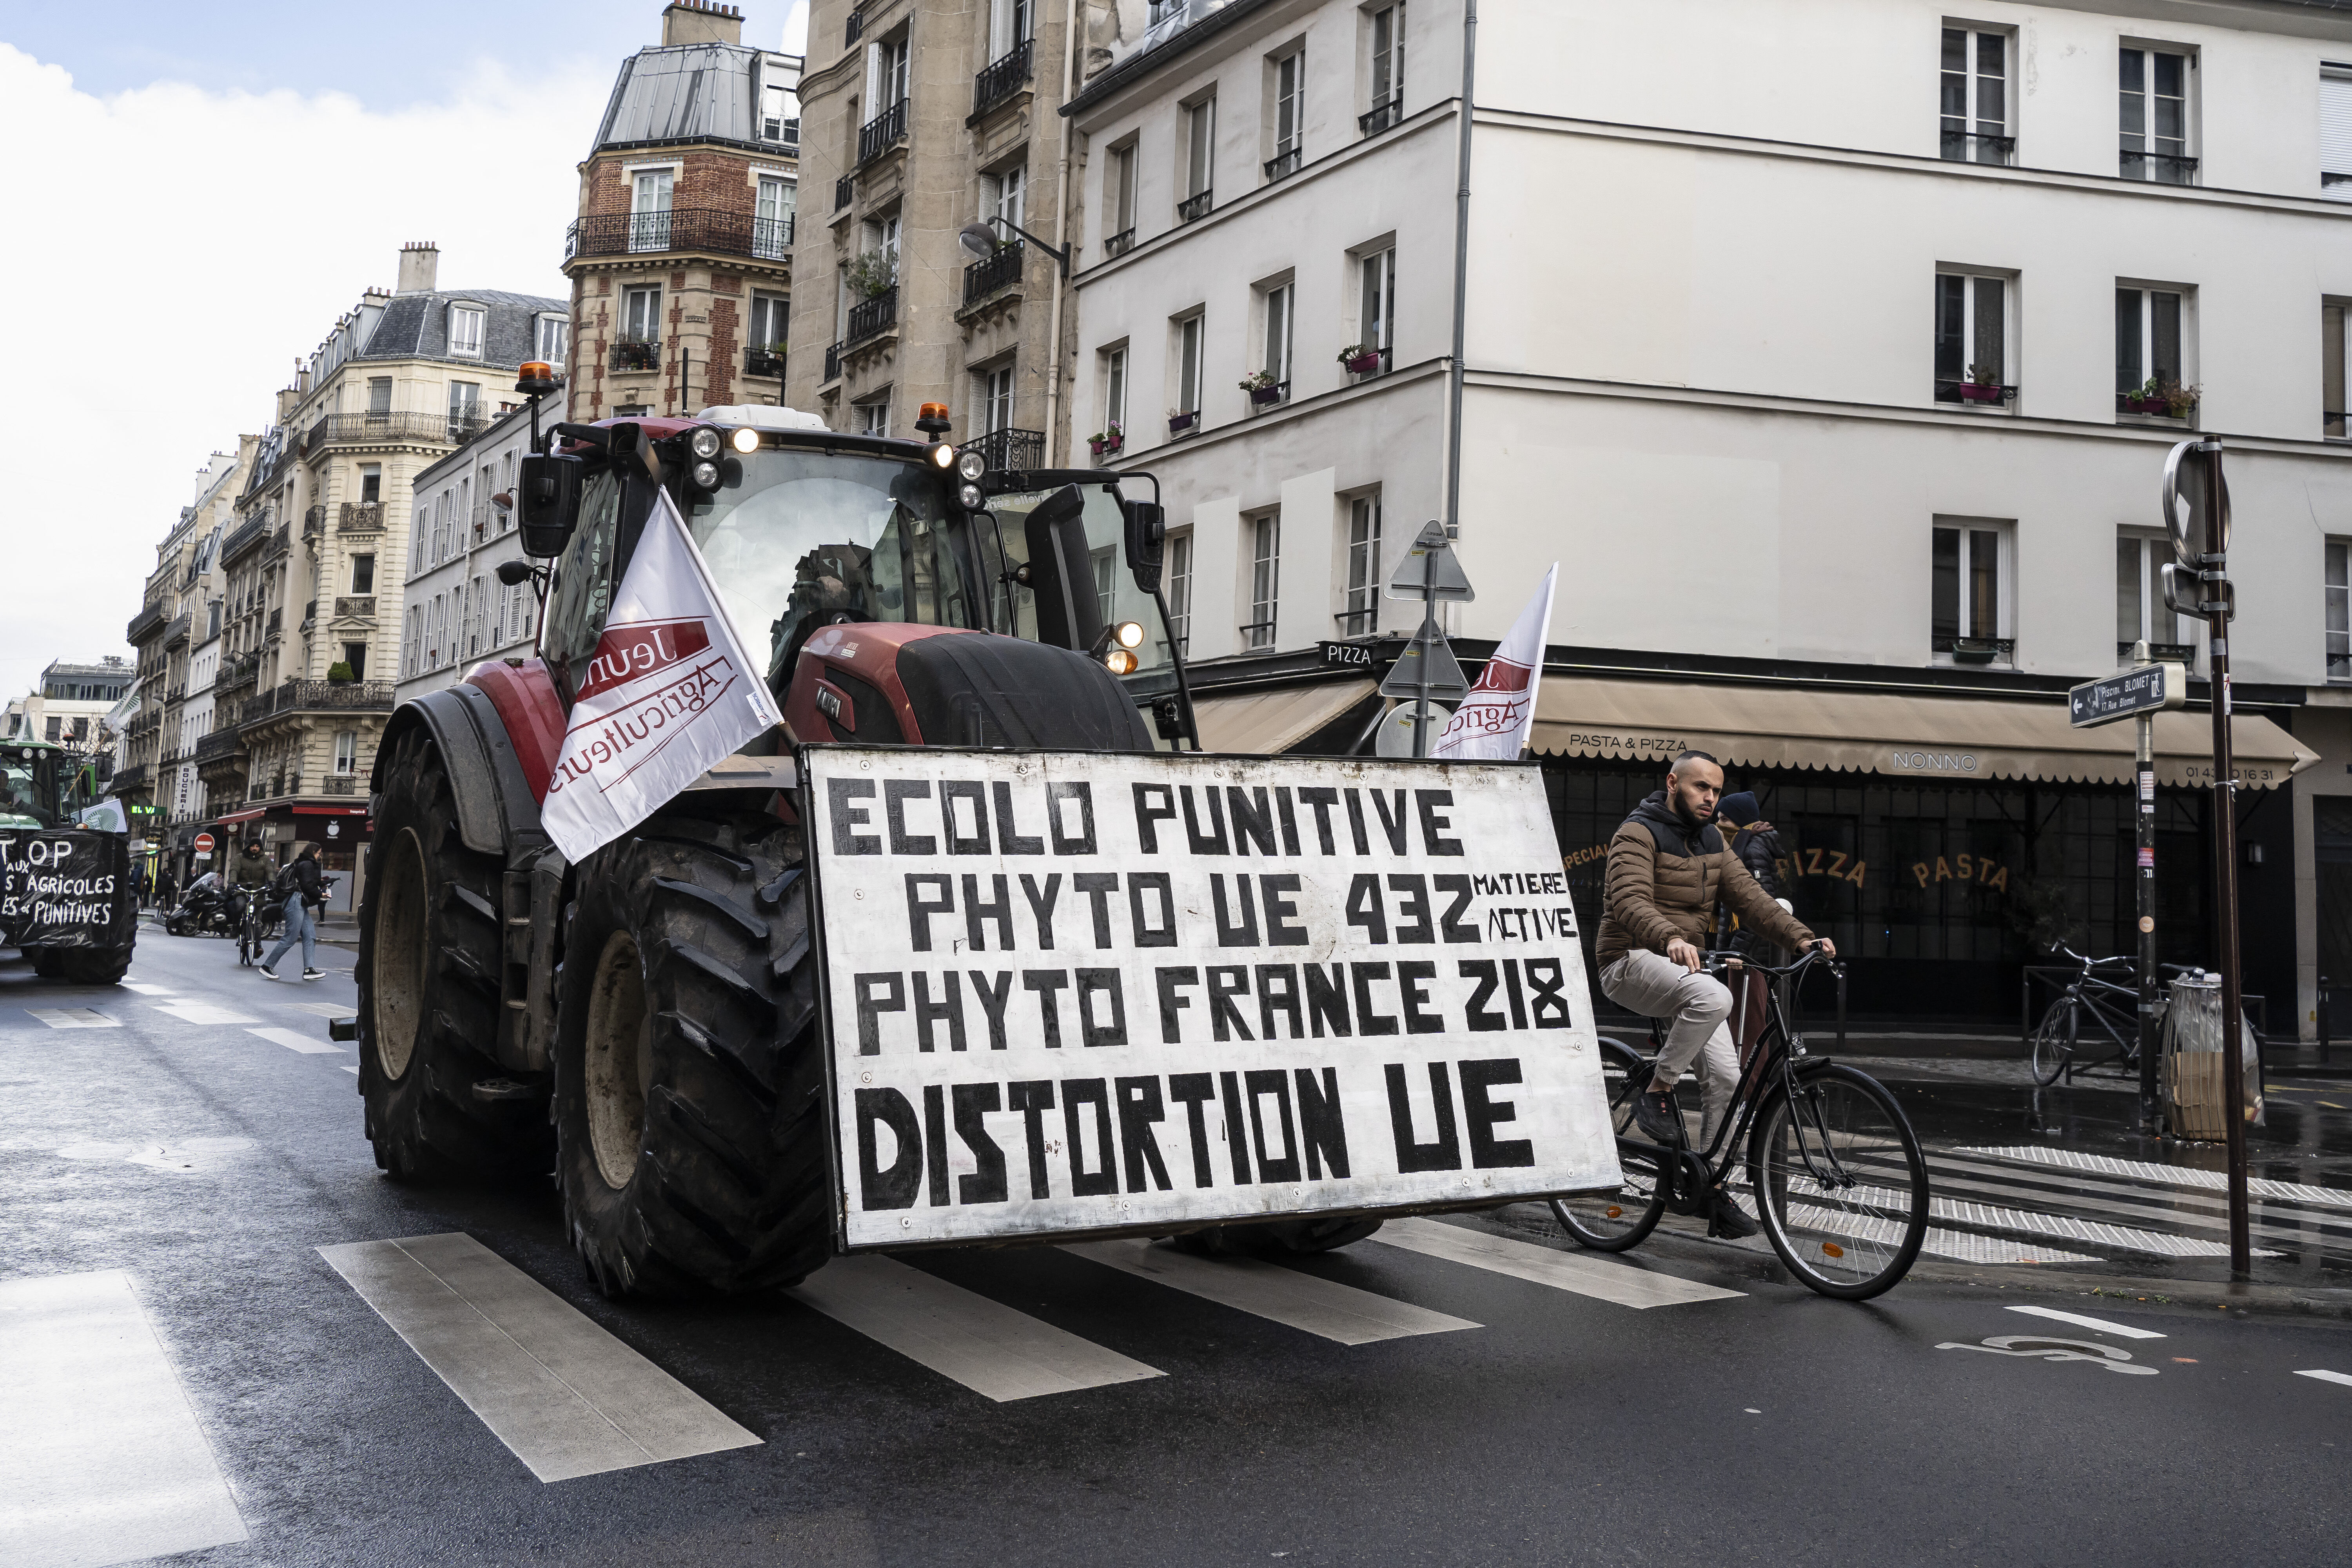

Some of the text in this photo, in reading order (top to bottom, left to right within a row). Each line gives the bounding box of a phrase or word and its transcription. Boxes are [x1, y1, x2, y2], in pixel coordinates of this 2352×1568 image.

[1328, 646, 1371, 664] PIZZA
[2125, 675, 2149, 692] BLOMET
[752, 693, 764, 711] BORNEY
[2120, 696, 2136, 707] Blomet
[1570, 734, 1688, 752] PASTA & PIZZA
[1893, 752, 1976, 771] NONNO
[2186, 767, 2198, 777] 01
[2244, 769, 2257, 780] 16
[2261, 770, 2273, 780] 31
[179, 768, 189, 814] BOUCHERIE
[827, 777, 1465, 857] ECOLO PUNITIVE
[6, 860, 29, 873] AUX
[1775, 848, 1866, 889] PIZZA
[1912, 853, 2009, 894] PASTA
[1473, 872, 1567, 896] MATIERE
[904, 872, 1481, 952] PHYTO UE 432
[1489, 907, 1579, 942] ACTIVE
[854, 957, 1572, 1056] PHYTO FRANCE 218
[855, 1058, 1535, 1212] DISTORTION UE
